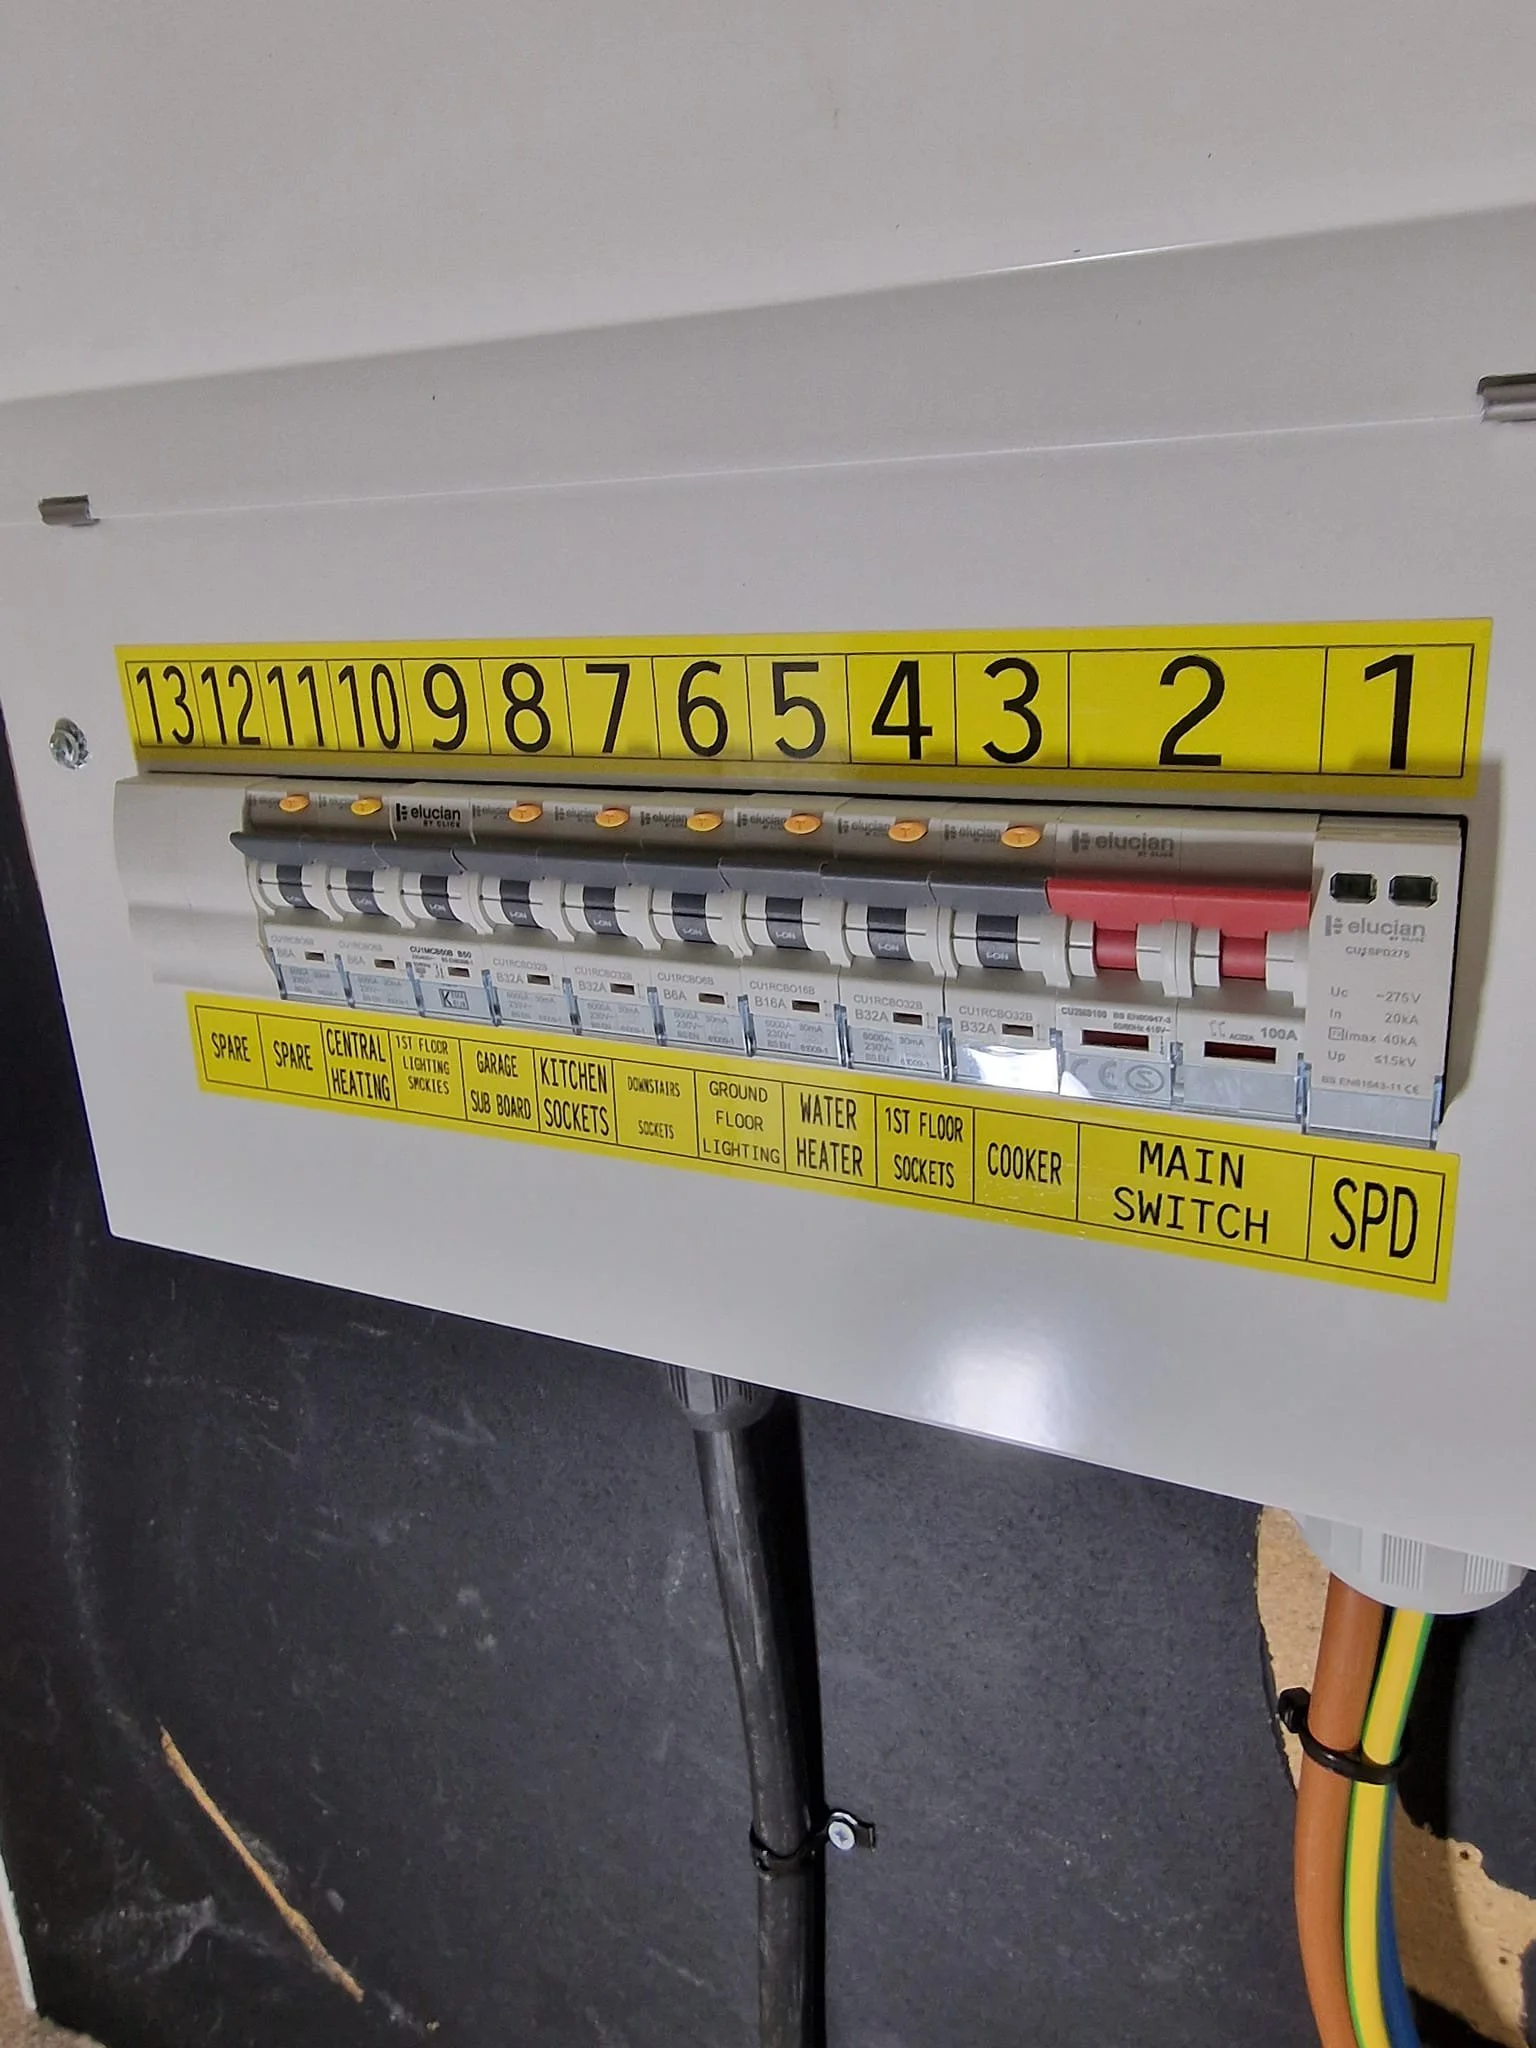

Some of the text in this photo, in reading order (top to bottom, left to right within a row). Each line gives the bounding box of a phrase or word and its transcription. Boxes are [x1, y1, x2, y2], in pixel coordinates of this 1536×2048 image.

[136, 654, 1414, 770] 13 12 11 10 9 8 7 6 5 4 3 2 1
[410, 804, 461, 821] elucian
[1095, 831, 1174, 851] elucian
[1347, 918, 1426, 938] elucian
[578, 981, 607, 993] B32A
[663, 987, 688, 1002] B6A
[755, 996, 788, 1010] B16A
[855, 1008, 889, 1022] B32A
[960, 1021, 997, 1035] B32A
[1260, 1027, 1298, 1042] 100A
[1383, 1033, 1418, 1047] 40kA
[211, 1031, 251, 1062] SPARE
[273, 1040, 313, 1071] SPARE
[326, 1028, 387, 1063] CENTRAL
[395, 1035, 449, 1055] 1ST FLOOR
[1327, 1049, 1346, 1064] Up
[402, 1055, 450, 1075] LIGHTING
[476, 1050, 519, 1078] GARAGE
[540, 1056, 608, 1094] KITCHEN
[331, 1067, 391, 1102] HEATING
[627, 1075, 681, 1098] DOWNSTAIRS
[709, 1080, 768, 1103] GROUND
[470, 1089, 531, 1120] SUB BOARD
[543, 1097, 610, 1136] SOCKETS
[799, 1091, 857, 1131] WATER
[638, 1119, 675, 1140] SOCKETS
[715, 1109, 764, 1132] FLOOR
[885, 1106, 963, 1143] 1ST FLOOR
[703, 1138, 781, 1164] LIGHTING
[796, 1136, 863, 1177] HEATER
[987, 1142, 1062, 1186] COOKER
[893, 1153, 955, 1189] SOCKETS
[1138, 1140, 1245, 1190] MAIN
[1113, 1186, 1270, 1245] SWITCH
[1329, 1176, 1418, 1260] SPD
